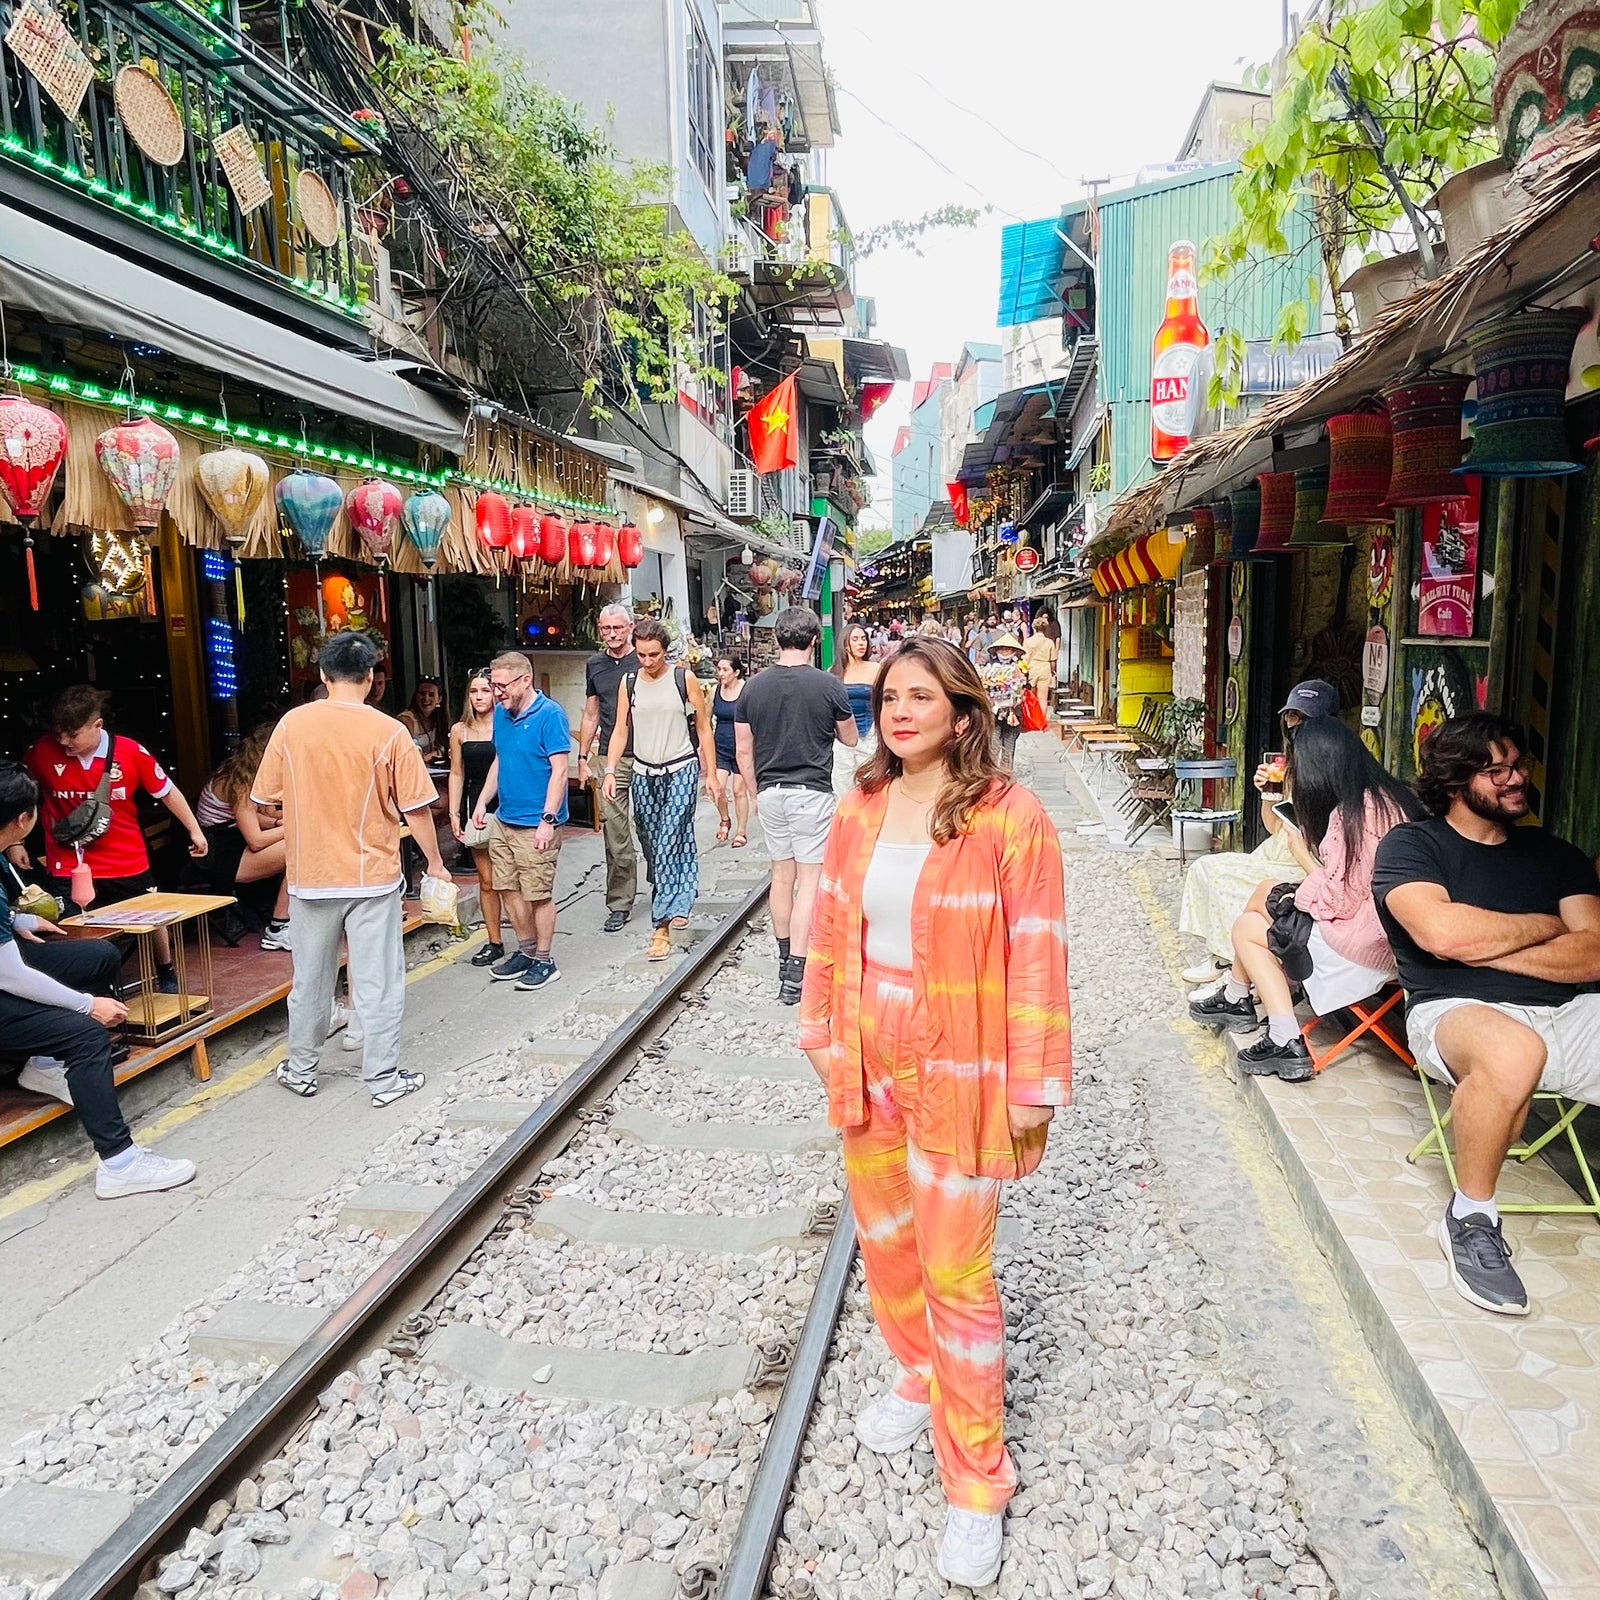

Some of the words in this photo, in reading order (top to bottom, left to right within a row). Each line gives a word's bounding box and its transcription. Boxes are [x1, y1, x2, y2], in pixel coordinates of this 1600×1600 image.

[1155, 379, 1188, 401] HAN
[1369, 643, 1384, 668] NO
[53, 790, 96, 800] NITE
[91, 816, 111, 837] York
